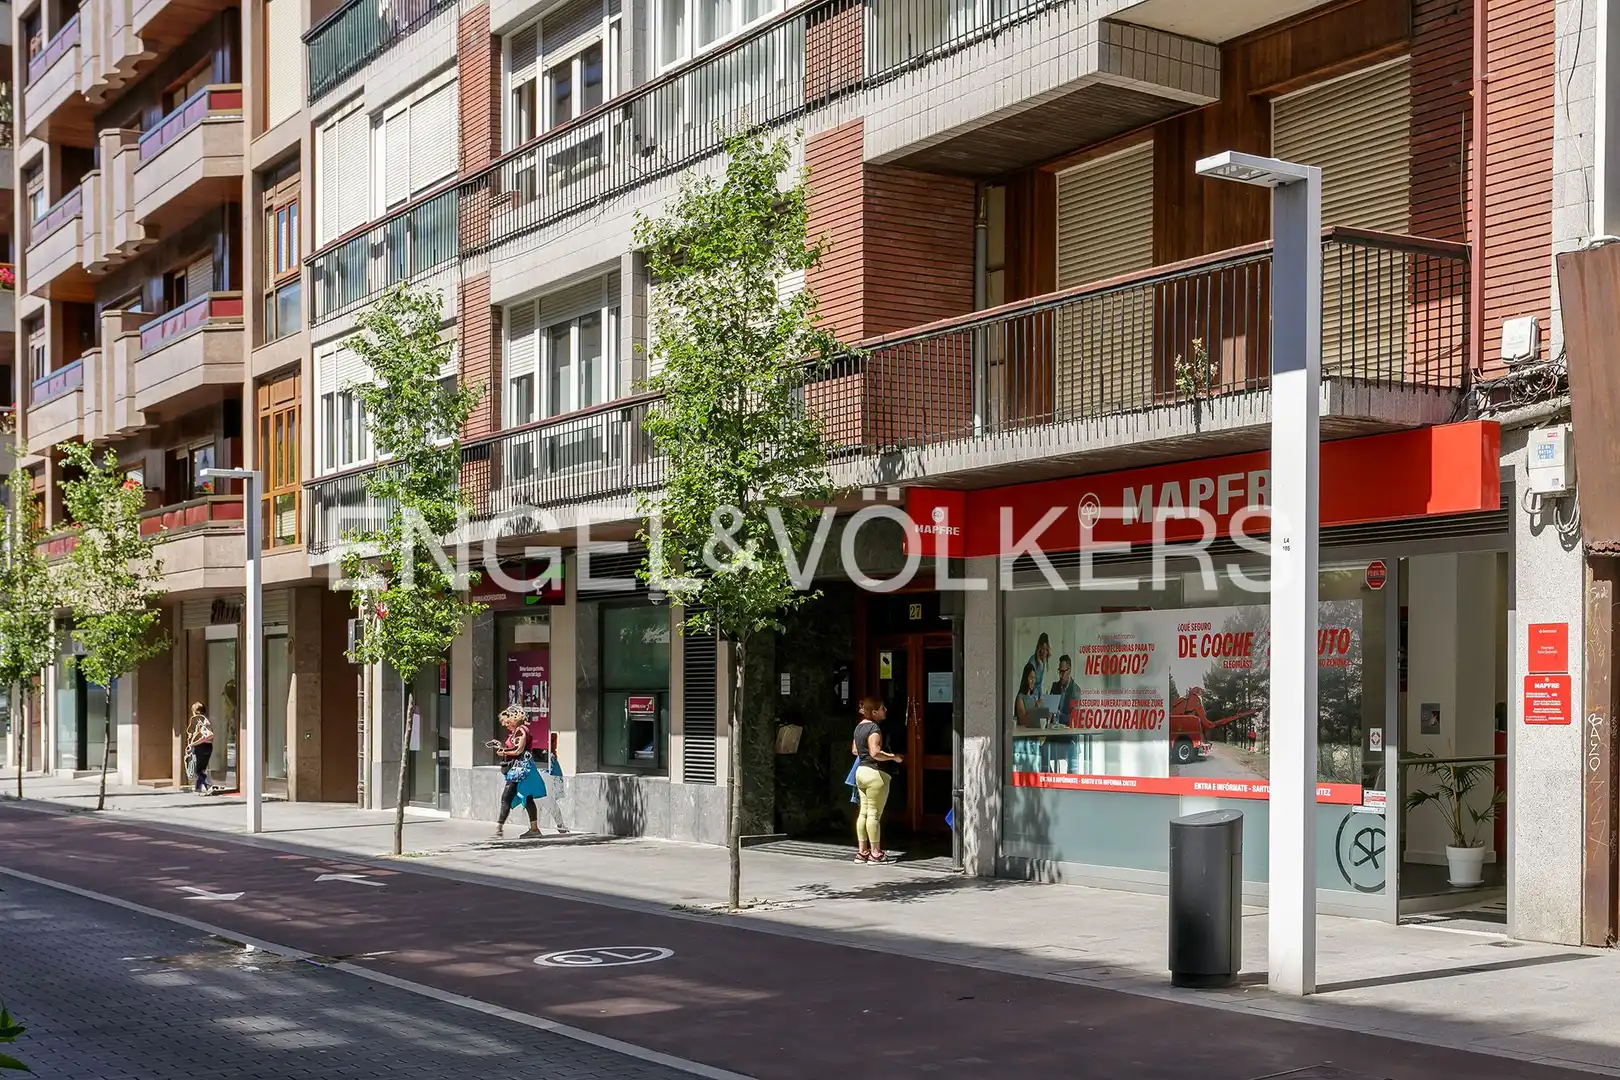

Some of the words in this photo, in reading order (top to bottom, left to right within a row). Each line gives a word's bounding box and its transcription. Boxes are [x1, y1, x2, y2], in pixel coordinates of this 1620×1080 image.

[1122, 469, 1271, 526] MAPFR
[915, 525, 960, 536] MAPFRE
[909, 604, 922, 619] 27
[1191, 622, 1211, 631] SEGURO
[1091, 643, 1110, 653] SEGURO
[1135, 643, 1148, 652] PARA
[1148, 643, 1155, 652] TU
[1178, 634, 1197, 658] DE
[1200, 631, 1254, 658] COCHE
[1317, 627, 1351, 656] UTO
[1085, 653, 1149, 675] NEGOCIO?
[1069, 708, 1165, 730] NEGOZIORAKO?
[1194, 782, 1211, 790] ENTRA
[1217, 782, 1248, 792] INFÓRMATE
[1252, 785, 1270, 793] SARTU
